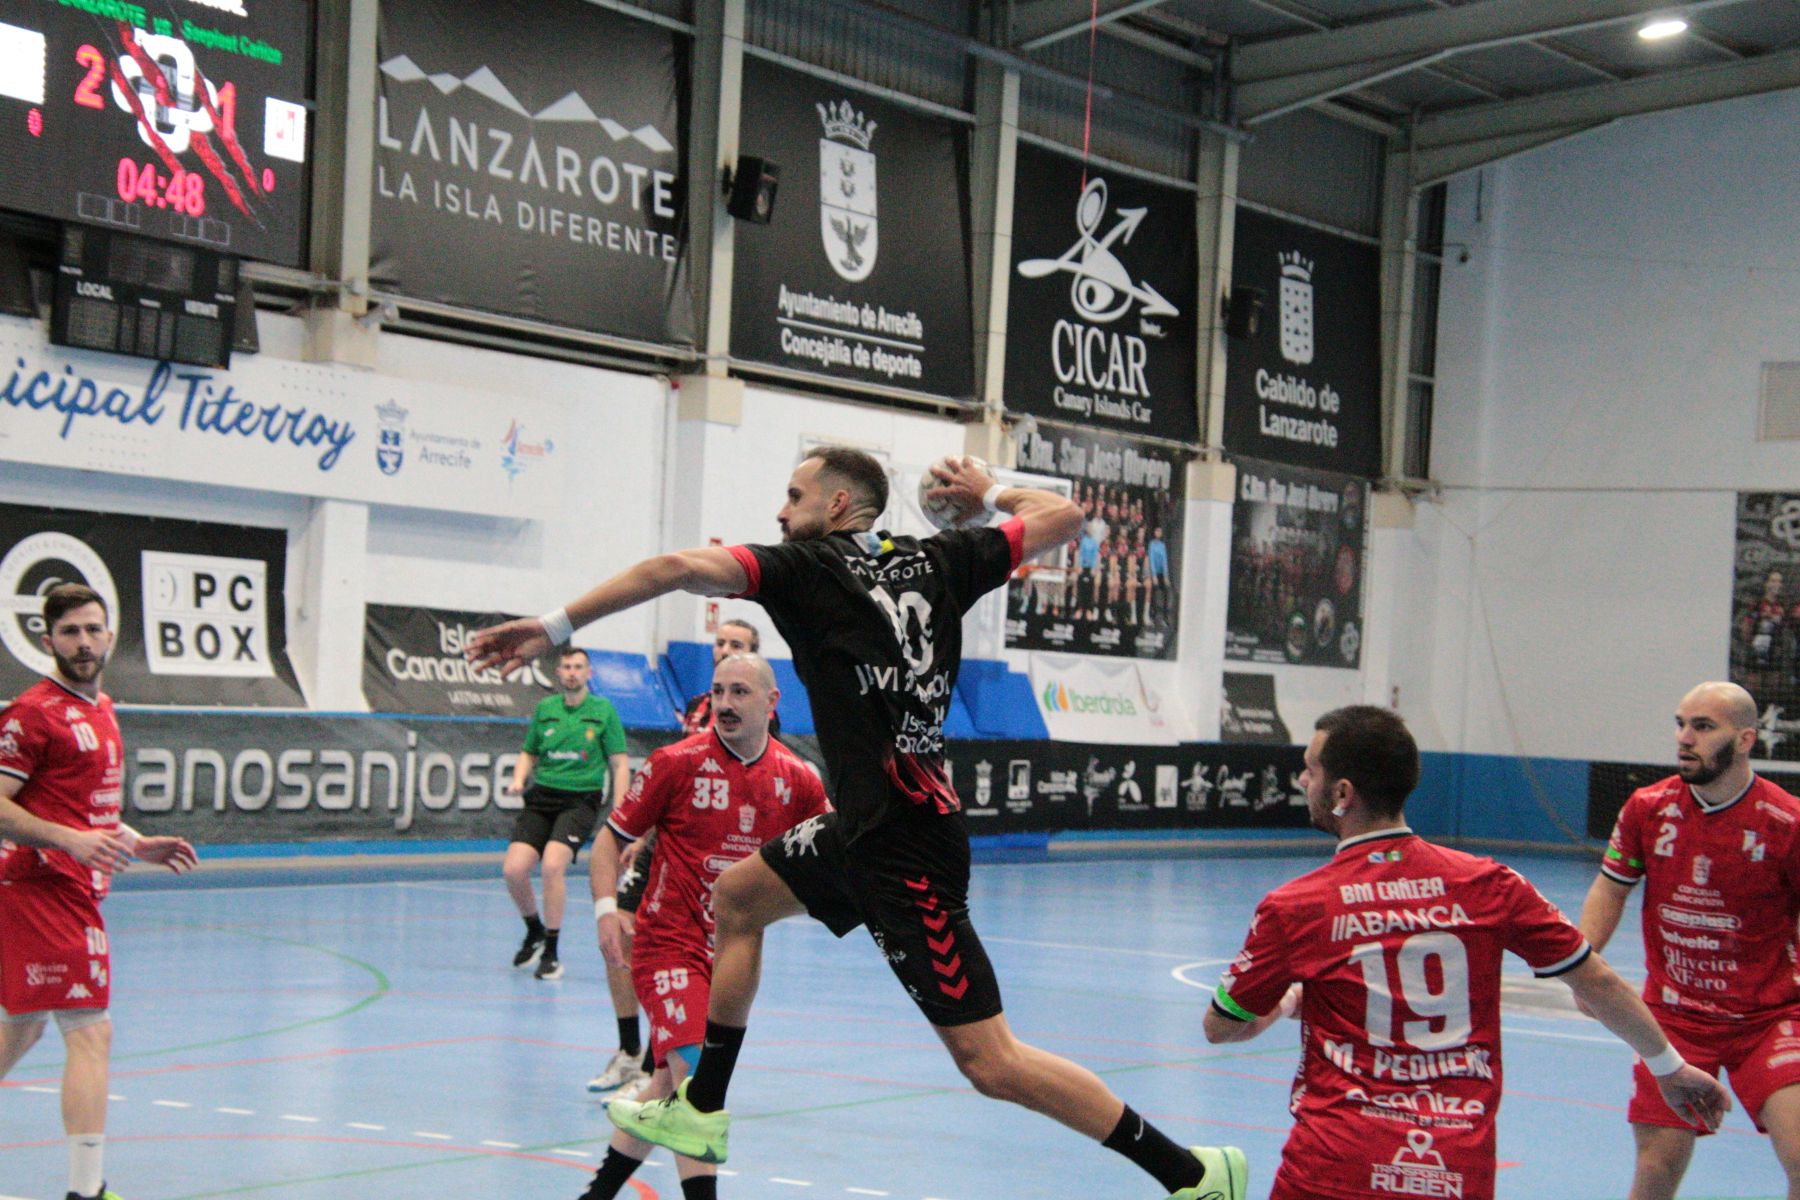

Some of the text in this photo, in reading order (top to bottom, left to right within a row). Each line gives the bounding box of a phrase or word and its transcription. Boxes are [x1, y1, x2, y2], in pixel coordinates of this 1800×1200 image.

[74, 44, 104, 110] 2
[217, 82, 237, 141] 1
[379, 96, 676, 218] LANZAROTE
[117, 157, 205, 216] 04:48
[379, 166, 677, 263] LA ISLA DIFERENTE
[76, 281, 114, 301] LOCAL
[778, 284, 923, 340] Ayuntamiento de Arrecife
[853, 342, 871, 369] de
[872, 346, 923, 379] deporte
[1052, 319, 1151, 398] CICAR
[1256, 368, 1340, 414] Cabildo de
[176, 374, 356, 471] Titerroy
[1132, 401, 1152, 423] Car
[1260, 404, 1338, 448] Lanzarote
[419, 446, 472, 469] Arrecife
[193, 572, 253, 613] PC
[158, 621, 258, 663] BOX
[1069, 688, 1137, 716] Iberdrola
[71, 722, 99, 752] 10
[692, 777, 730, 811] 33
[1654, 823, 1678, 857] 2
[1340, 876, 1446, 905] BM CAÑIZA
[1347, 930, 1473, 1051] 19
[1323, 1038, 1363, 1076] M.
[1370, 1172, 1463, 1200] RUBEN
[1371, 1162, 1464, 1182] TRANSPORTES
